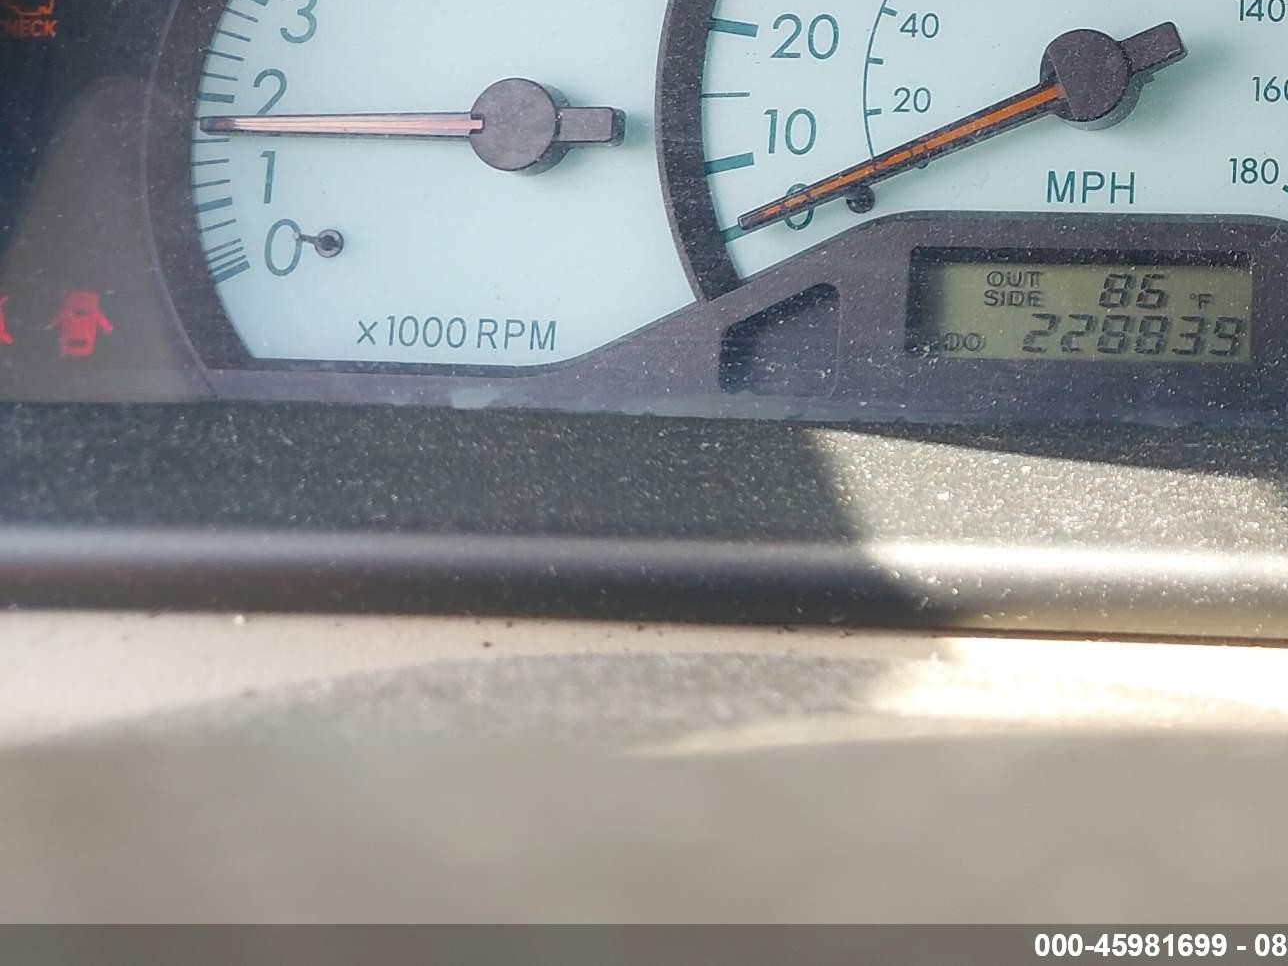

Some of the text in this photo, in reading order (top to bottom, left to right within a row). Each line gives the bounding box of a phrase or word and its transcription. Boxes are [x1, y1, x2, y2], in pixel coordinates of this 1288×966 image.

[771, 14, 839, 60] 20
[899, 11, 939, 39] 40
[252, 69, 288, 117] 2
[893, 86, 931, 113] 20
[766, 108, 817, 155] 10
[260, 150, 275, 203] 1
[1229, 156, 1279, 184] 180
[1046, 172, 1136, 205] MPH
[265, 218, 302, 276] 0
[987, 271, 1042, 288] OUT
[984, 290, 1042, 307] SIDE
[477, 320, 558, 351] RPM
[1023, 313, 1243, 354] 228839
